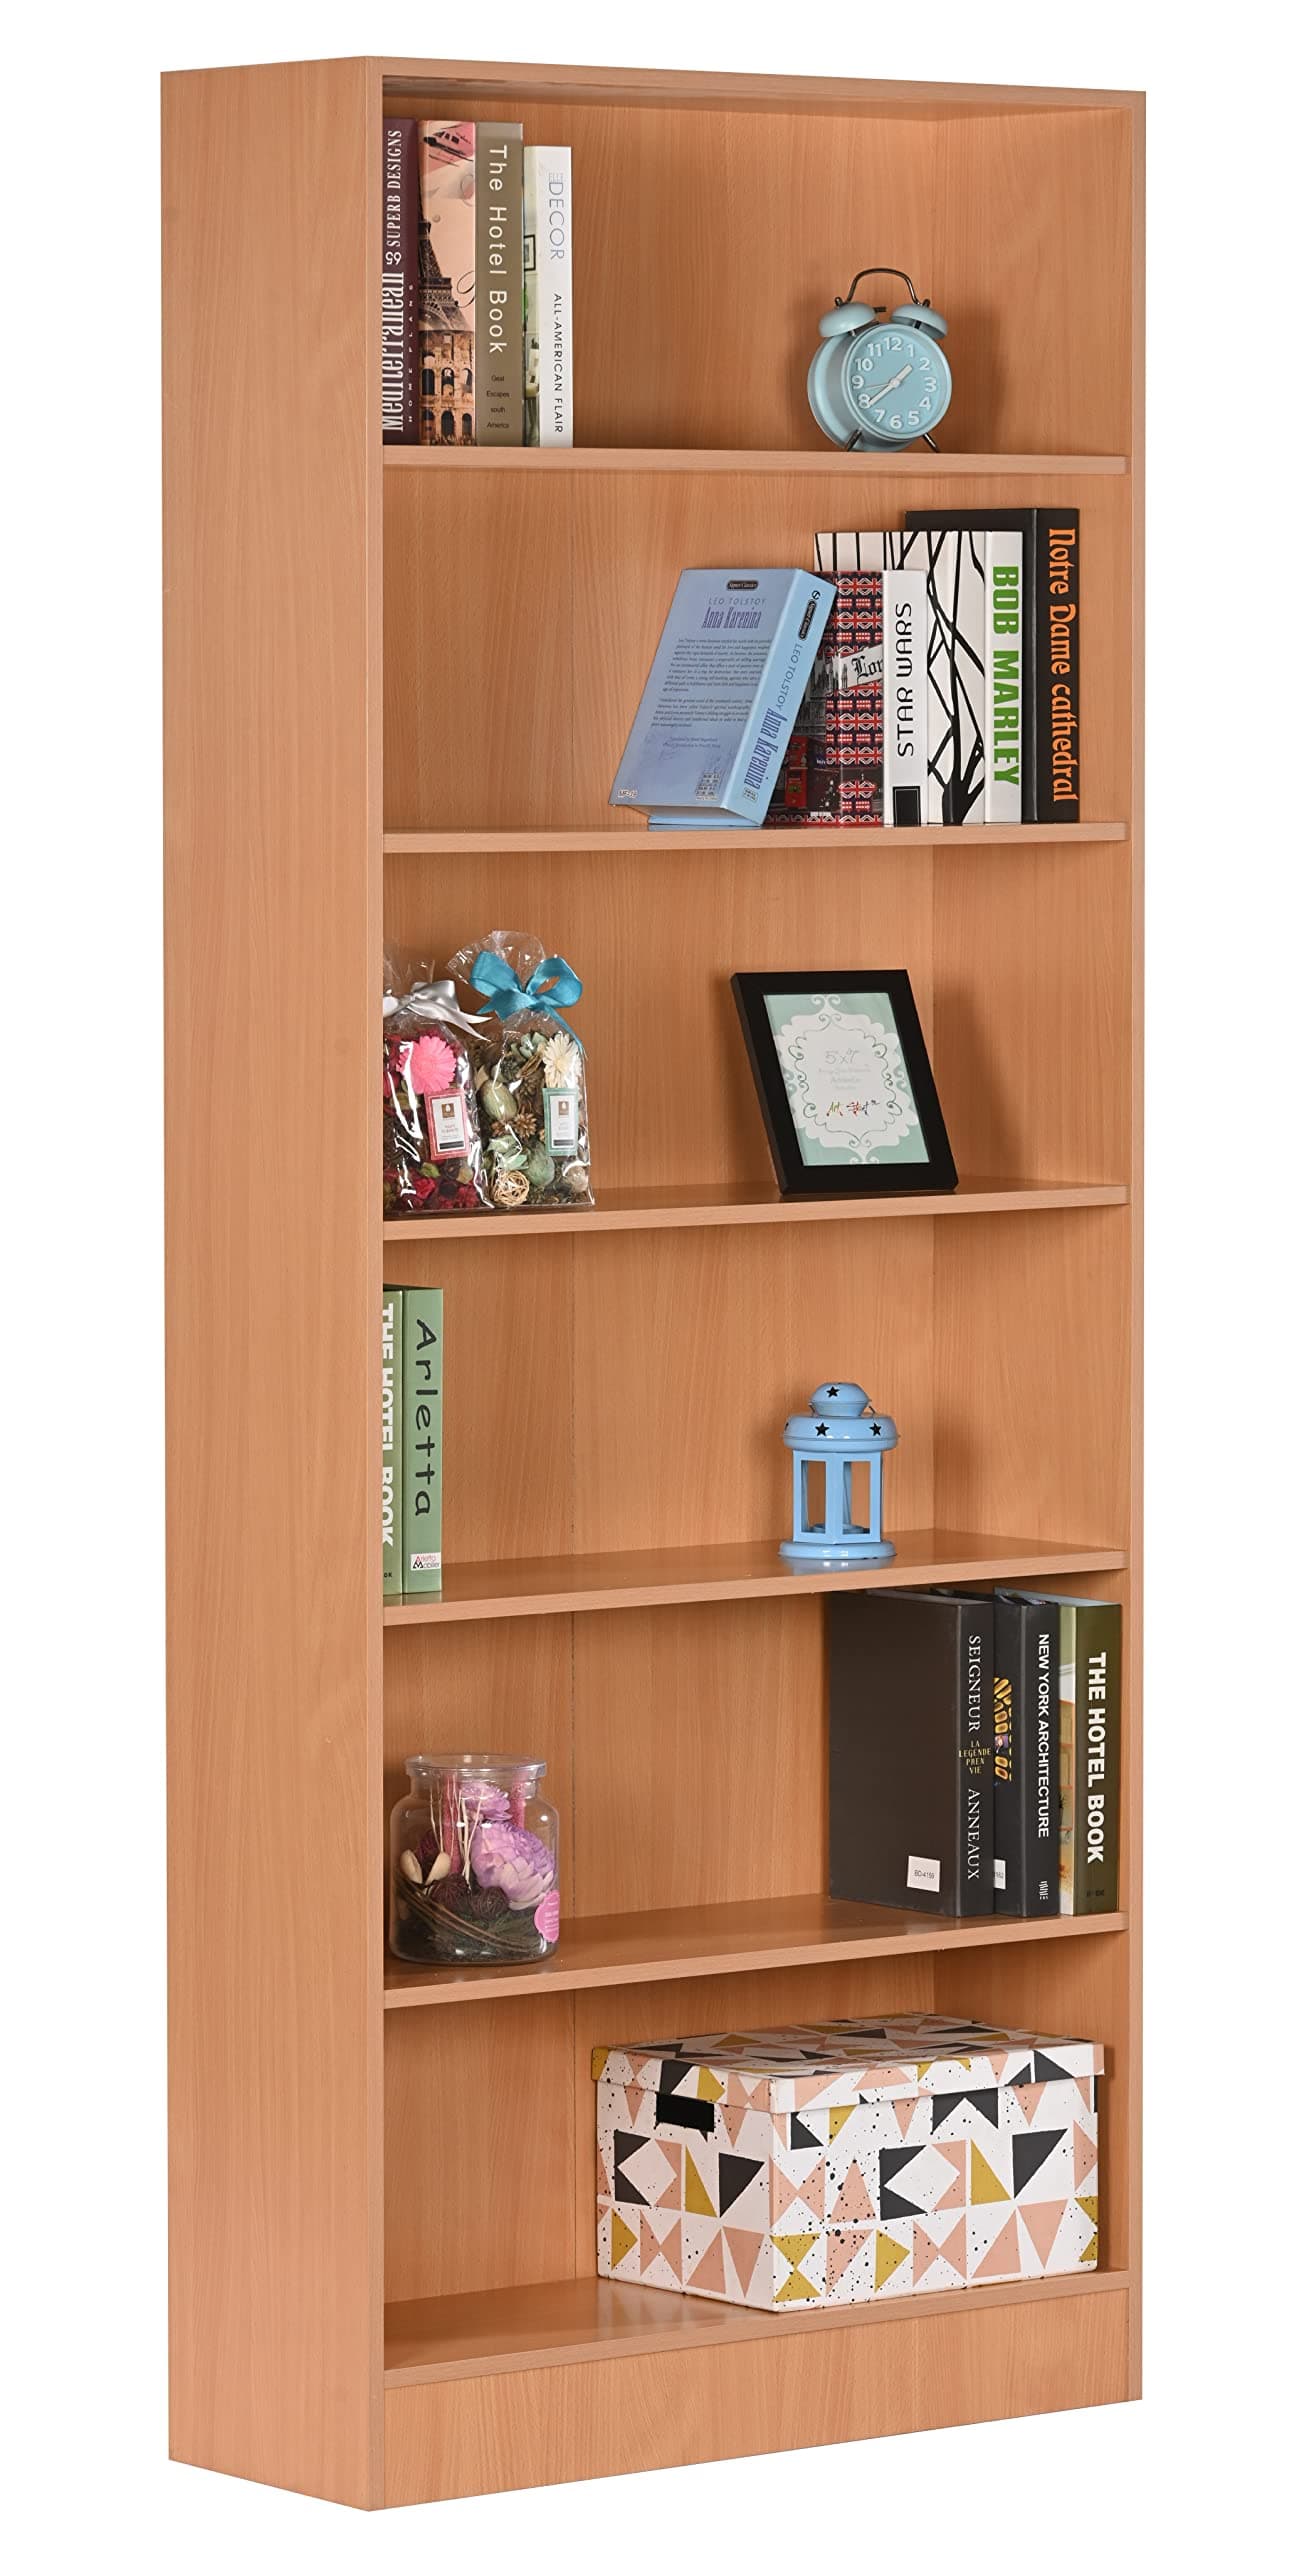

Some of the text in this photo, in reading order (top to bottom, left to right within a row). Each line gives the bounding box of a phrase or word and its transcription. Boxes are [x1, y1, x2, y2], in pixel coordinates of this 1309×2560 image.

[388, 130, 401, 189] DESIGNS
[387, 195, 400, 246] SUPERB
[386, 252, 402, 265] 65
[490, 145, 507, 353] The Hotel Book
[868, 344, 882, 356] 11
[884, 337, 902, 351] 12
[908, 345, 914, 357] 1
[553, 294, 564, 433] ALL-AMERICAN FLAIR
[855, 359, 873, 371] 10
[919, 358, 930, 370] 2
[852, 376, 864, 389] 9
[925, 378, 936, 392] 3
[858, 394, 870, 408] 8
[920, 397, 931, 410] 4
[875, 409, 885, 422] 7
[890, 415, 902, 428] 6
[908, 411, 919, 425] 5
[702, 607, 762, 629] Anna Karenina
[777, 644, 803, 709] LEO TOLSTOY
[993, 566, 1020, 785] BOB MARLEY
[1048, 528, 1080, 803] Notre Dame cathedral
[896, 603, 914, 756] STAR WARS
[761, 708, 787, 738] Anna
[744, 736, 779, 789] Karenina
[415, 1318, 438, 1516] Arletta
[967, 1635, 981, 1732] SEIGNEUR
[1038, 1634, 1049, 1838] NEW YORK ARCHITECTURE
[959, 1748, 991, 1757] LEGENDE
[1087, 1652, 1107, 1864] THE HOTEL BOOK
[967, 1788, 981, 1879] ANNEAUX
